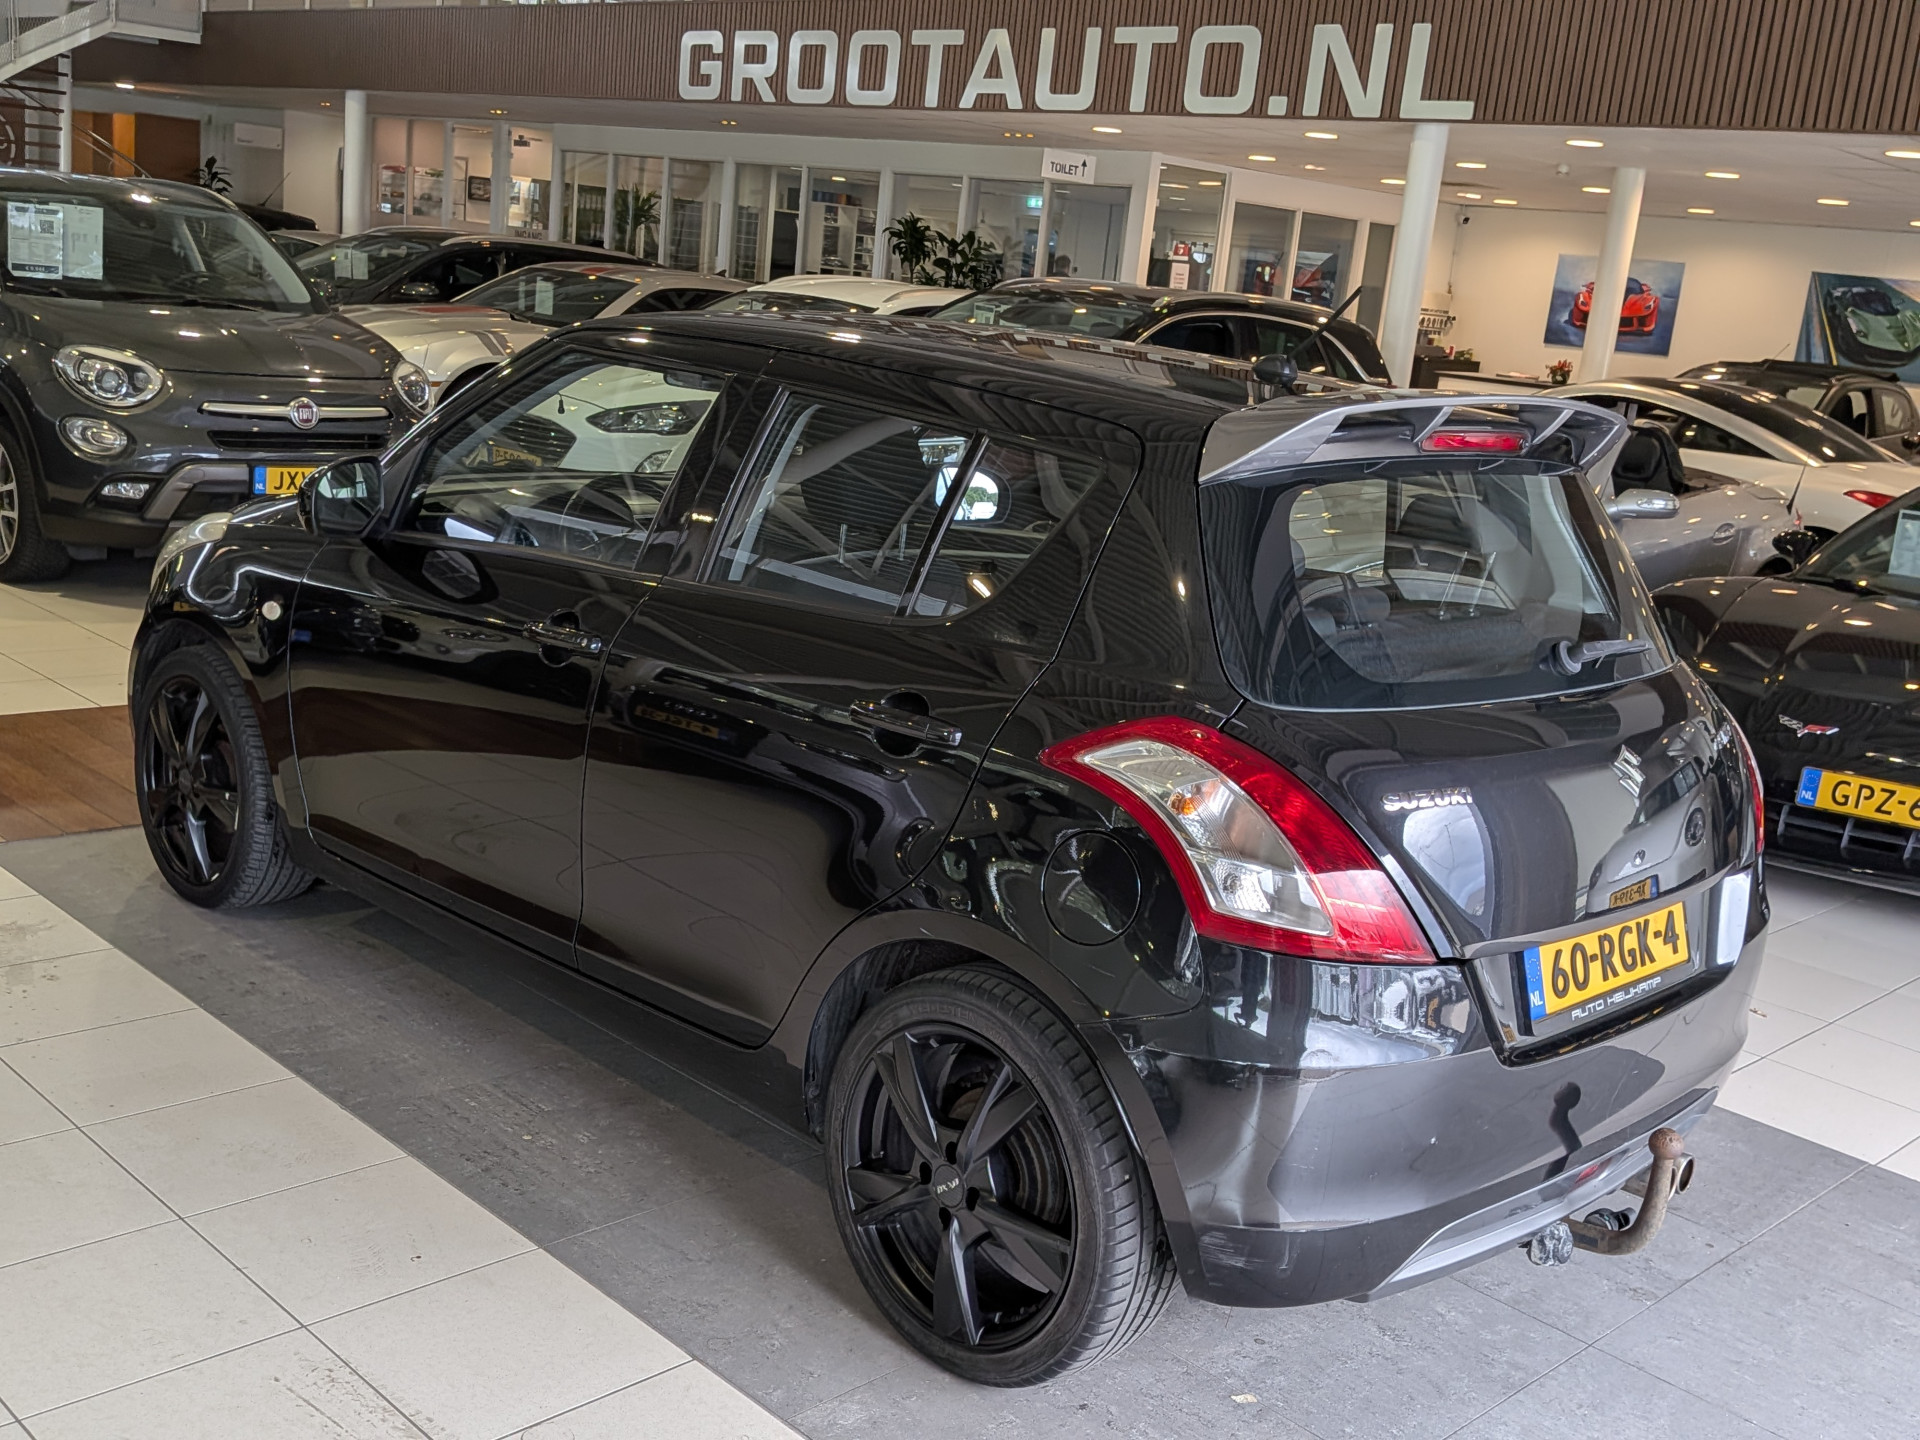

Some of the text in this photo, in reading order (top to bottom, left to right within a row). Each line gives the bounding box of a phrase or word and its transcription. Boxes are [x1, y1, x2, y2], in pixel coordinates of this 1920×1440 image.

[678, 23, 1475, 120] GROOTAUTO.NL
[1050, 160, 1080, 176] TOILET
[299, 408, 312, 420] FIAT
[255, 483, 266, 491] NL
[1381, 786, 1473, 812] SUZUKI
[1801, 790, 1814, 800] NL
[1530, 910, 1681, 1008] NL 60-RGK-4
[1571, 1000, 1605, 1021] AUTO
